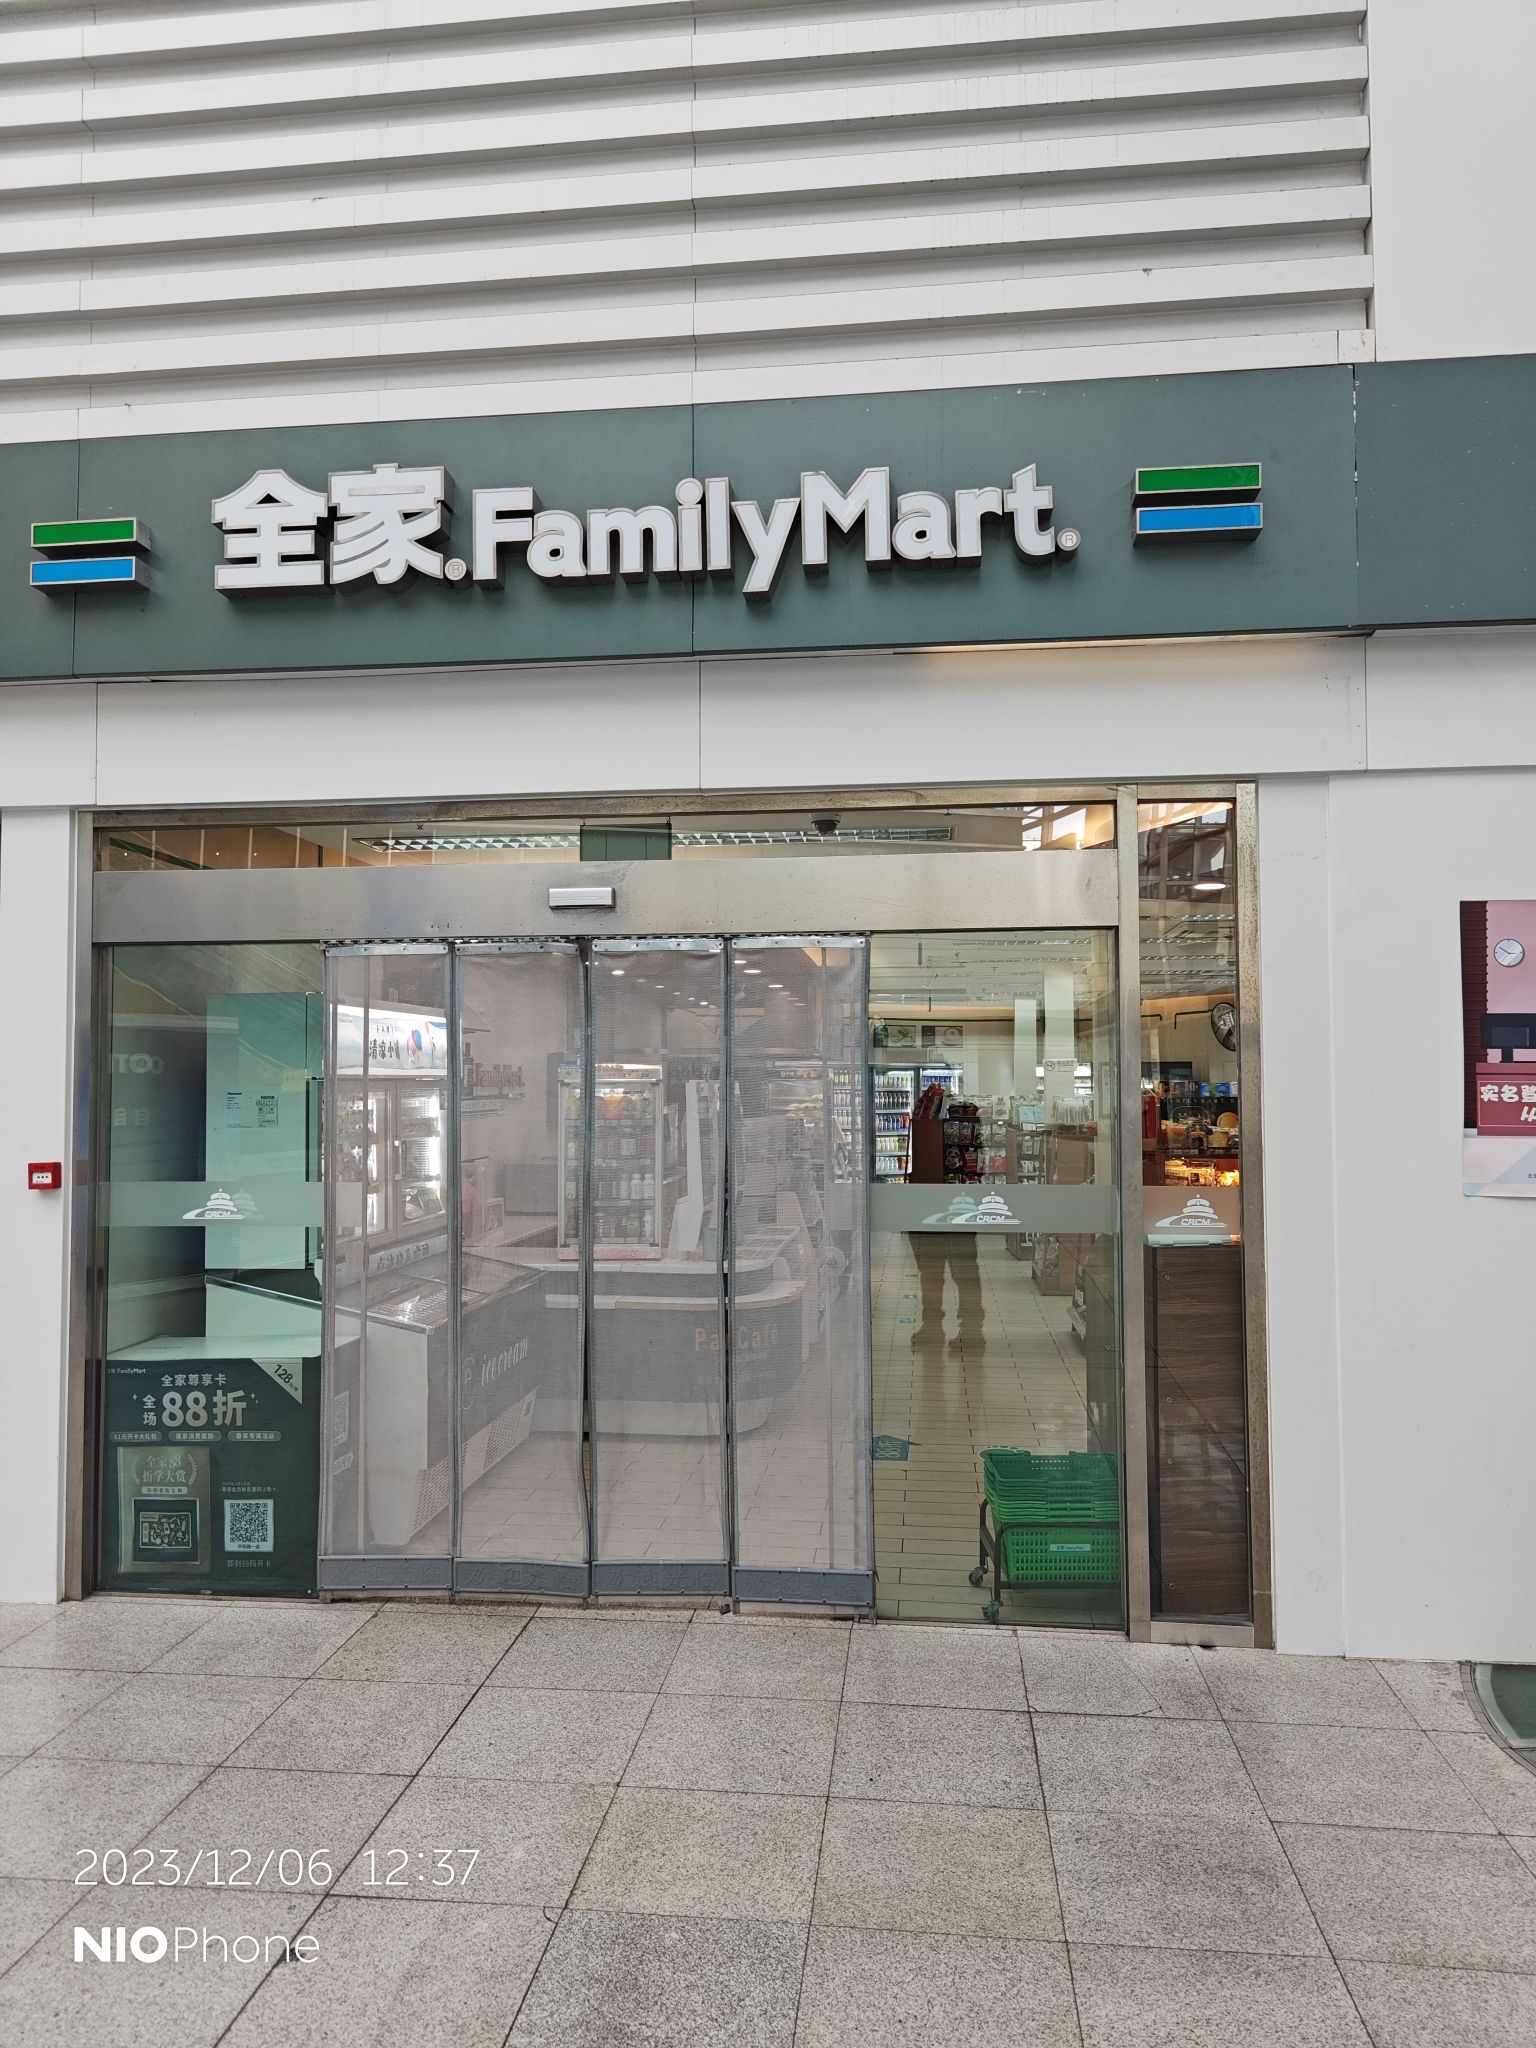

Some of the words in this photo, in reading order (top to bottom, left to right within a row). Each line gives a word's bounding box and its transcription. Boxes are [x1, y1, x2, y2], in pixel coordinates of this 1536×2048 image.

[211, 463, 448, 586] 全家
[472, 462, 1057, 598] FamilyMart
[976, 1215, 1006, 1223] CRCM
[1180, 1218, 1212, 1226] CRCM
[161, 1373, 227, 1387] 全家尊享卡
[274, 1364, 293, 1384] 128
[142, 1394, 157, 1426] 全场
[161, 1389, 247, 1428] 88折
